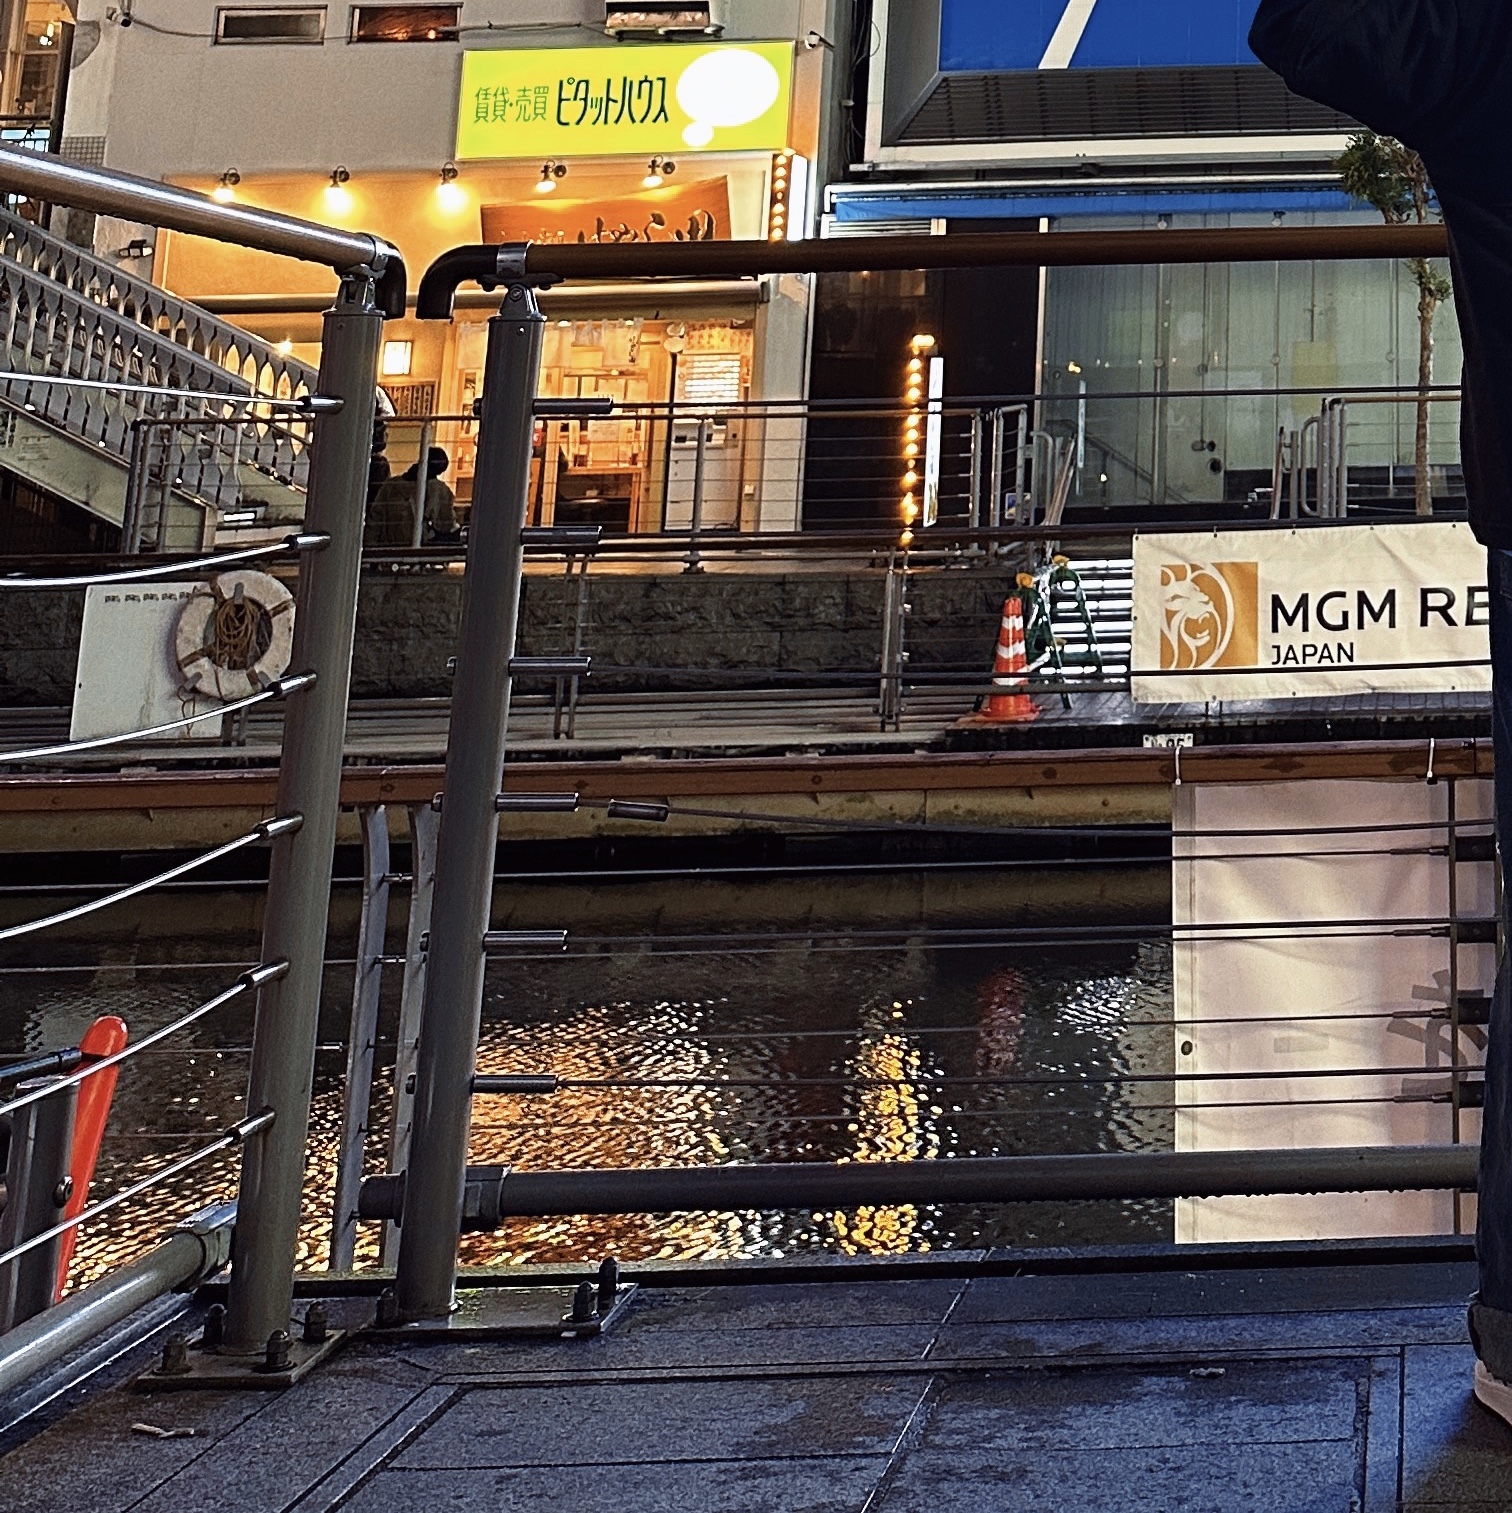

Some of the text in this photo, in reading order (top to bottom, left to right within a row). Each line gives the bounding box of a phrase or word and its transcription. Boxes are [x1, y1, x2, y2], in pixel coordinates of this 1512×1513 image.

[556, 75, 669, 127] ピタットハウス
[1270, 587, 1397, 634] MGM
[1271, 642, 1355, 666] JAPAN
